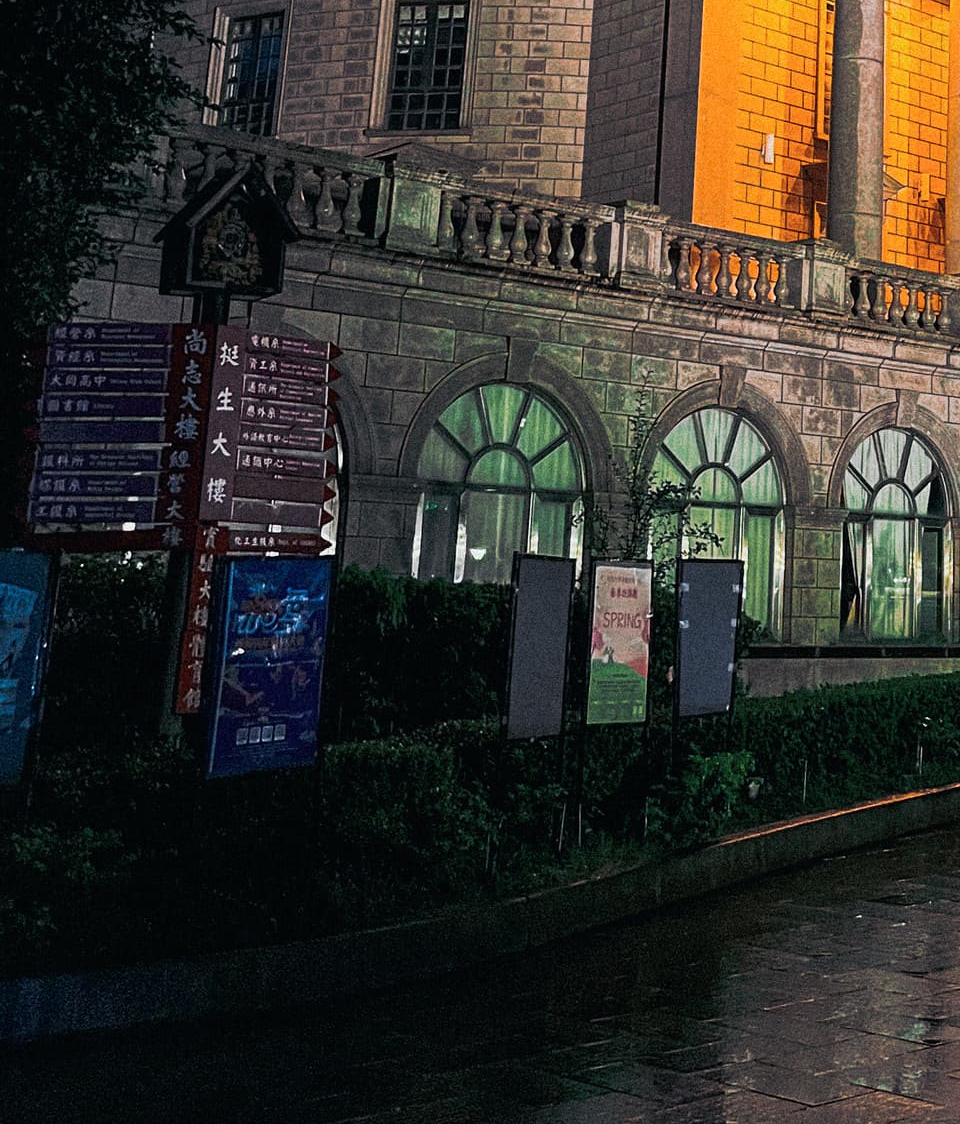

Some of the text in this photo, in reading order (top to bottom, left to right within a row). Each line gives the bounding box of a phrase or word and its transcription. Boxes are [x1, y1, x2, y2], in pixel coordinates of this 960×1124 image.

[49, 373, 107, 388] 大同高中
[173, 328, 207, 442] 尚志大樓
[205, 341, 240, 504] 挺生大樓
[603, 612, 642, 629] SPRING
